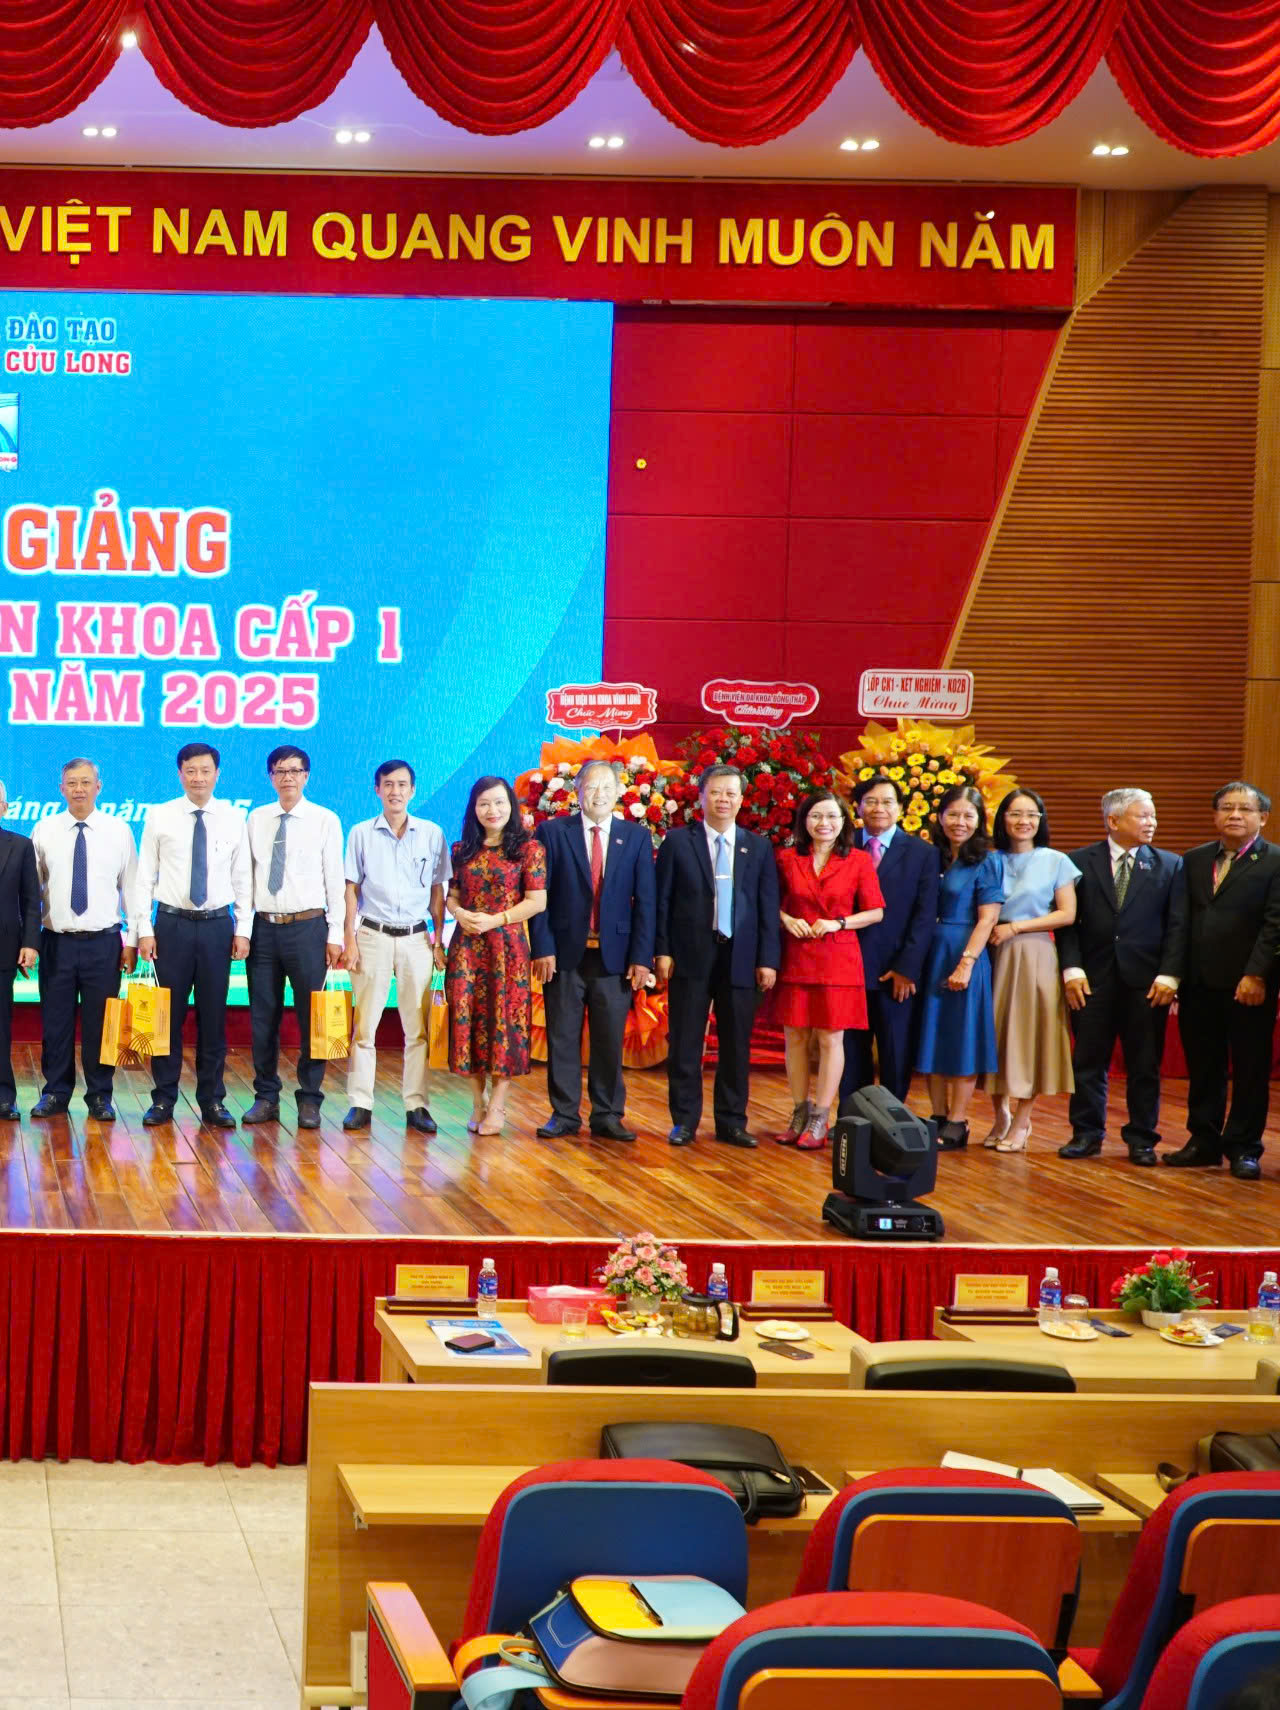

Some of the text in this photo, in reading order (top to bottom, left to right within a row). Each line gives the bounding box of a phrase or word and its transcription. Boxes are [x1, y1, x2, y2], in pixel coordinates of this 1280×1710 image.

[151, 206, 290, 258] NAM
[311, 211, 533, 264] QUANG
[552, 215, 694, 264] VINH
[718, 212, 896, 268] MUÔN
[920, 209, 1056, 271] NĂM
[5, 345, 57, 374] CỬU
[65, 351, 131, 375] LONG
[7, 312, 58, 341] ĐÀO
[66, 317, 117, 345] TẠO
[6, 491, 227, 574] GIẢNG
[58, 605, 217, 658] KHOA
[238, 593, 352, 662] CẤP
[380, 609, 399, 662] 1
[11, 666, 142, 724] NĂM
[165, 674, 317, 728] 2025
